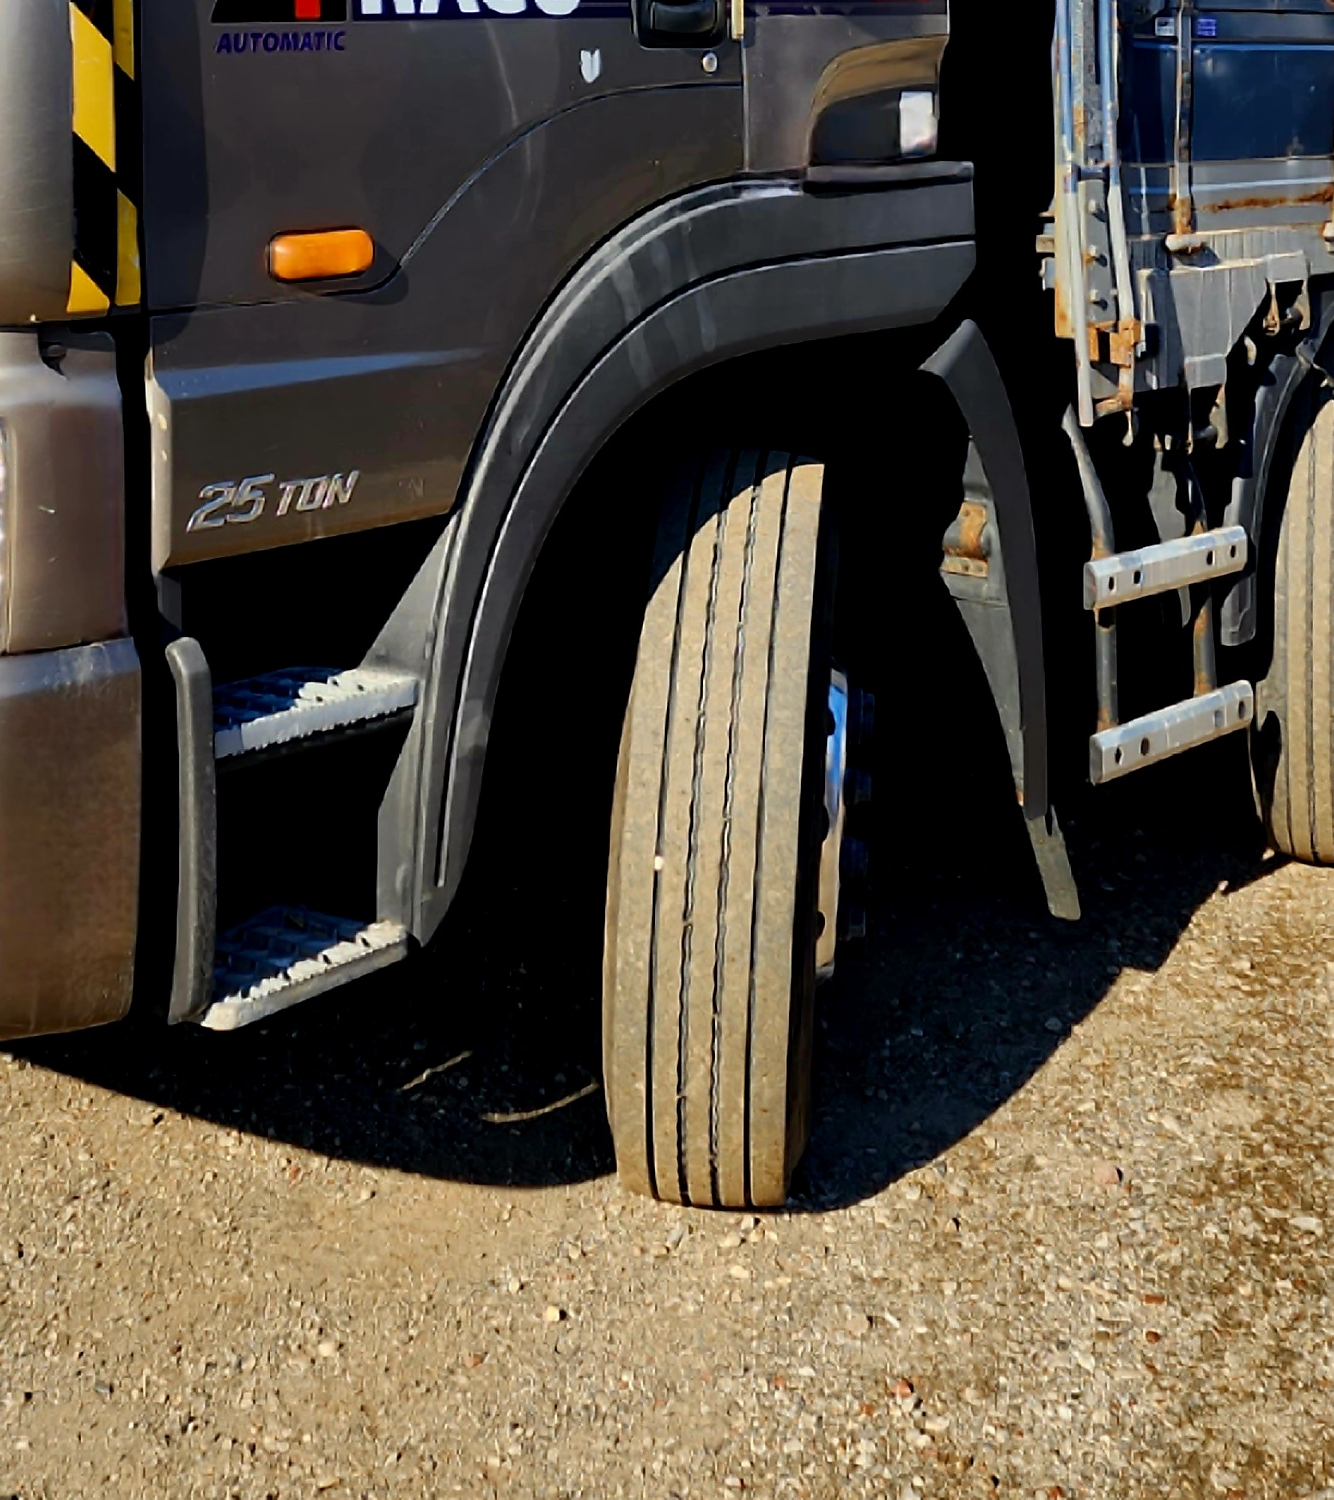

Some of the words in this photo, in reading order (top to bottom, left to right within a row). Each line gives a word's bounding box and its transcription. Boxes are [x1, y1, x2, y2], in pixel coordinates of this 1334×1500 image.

[215, 30, 346, 54] AUTOMATIC
[185, 472, 276, 534] 25
[276, 469, 361, 518] TON
